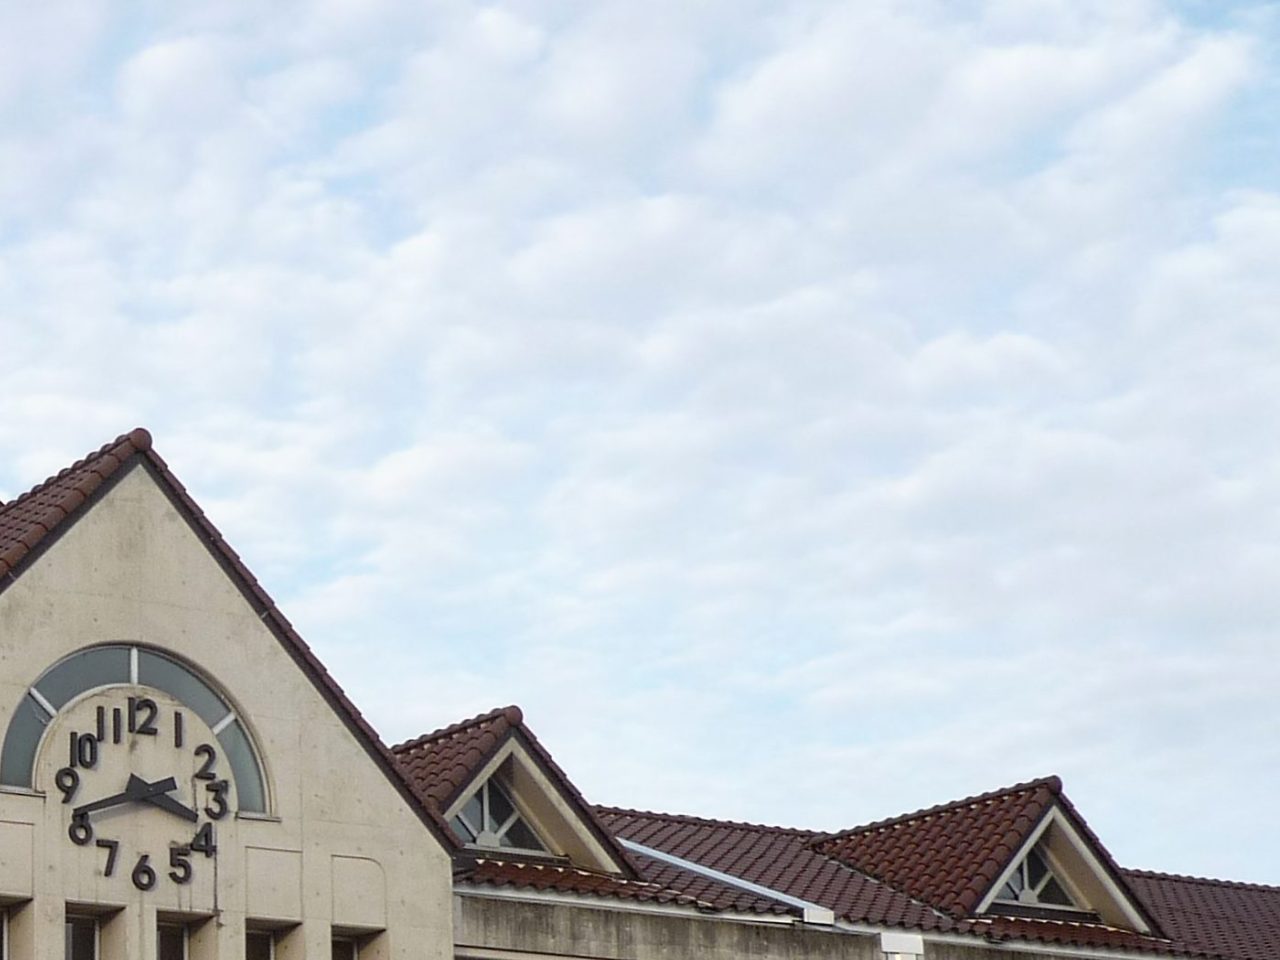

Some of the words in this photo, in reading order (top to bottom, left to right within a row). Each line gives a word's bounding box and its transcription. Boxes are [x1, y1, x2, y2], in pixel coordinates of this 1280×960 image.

[97, 705, 121, 745] 11
[127, 697, 158, 735] 12
[174, 712, 183, 748] 1
[70, 732, 98, 769] 10
[194, 744, 216, 781] 2
[55, 767, 80, 804] 9
[204, 780, 229, 820] 3
[68, 811, 93, 846] 8
[190, 822, 217, 858] 4
[96, 839, 119, 877] 7
[131, 855, 156, 891] 6
[168, 847, 192, 884] 5
